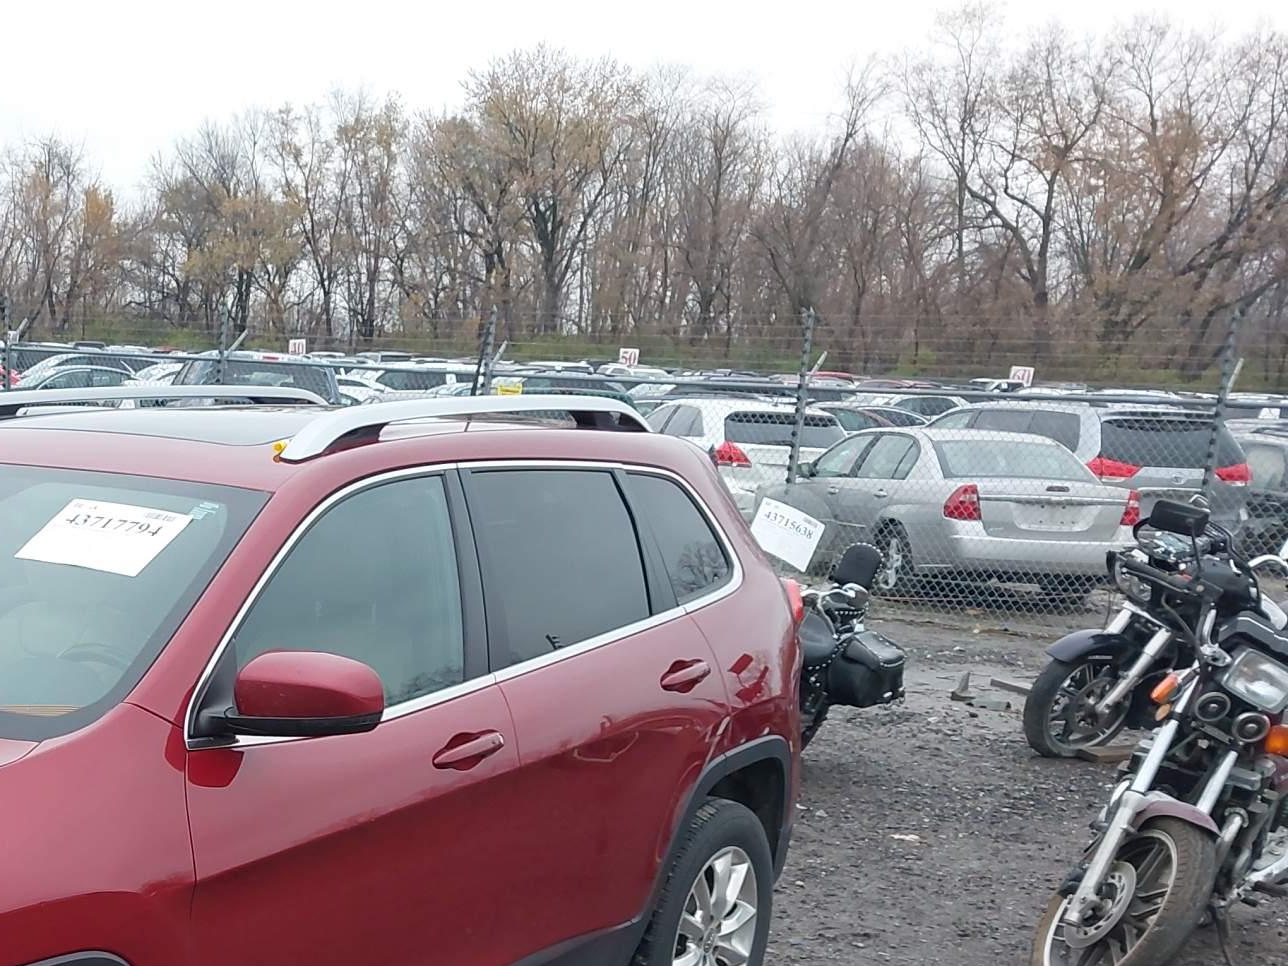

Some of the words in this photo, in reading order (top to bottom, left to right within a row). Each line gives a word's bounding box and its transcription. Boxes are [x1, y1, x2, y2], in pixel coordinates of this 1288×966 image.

[621, 350, 637, 366] 50
[65, 512, 163, 537] 43717794
[763, 510, 815, 540] 43715638
